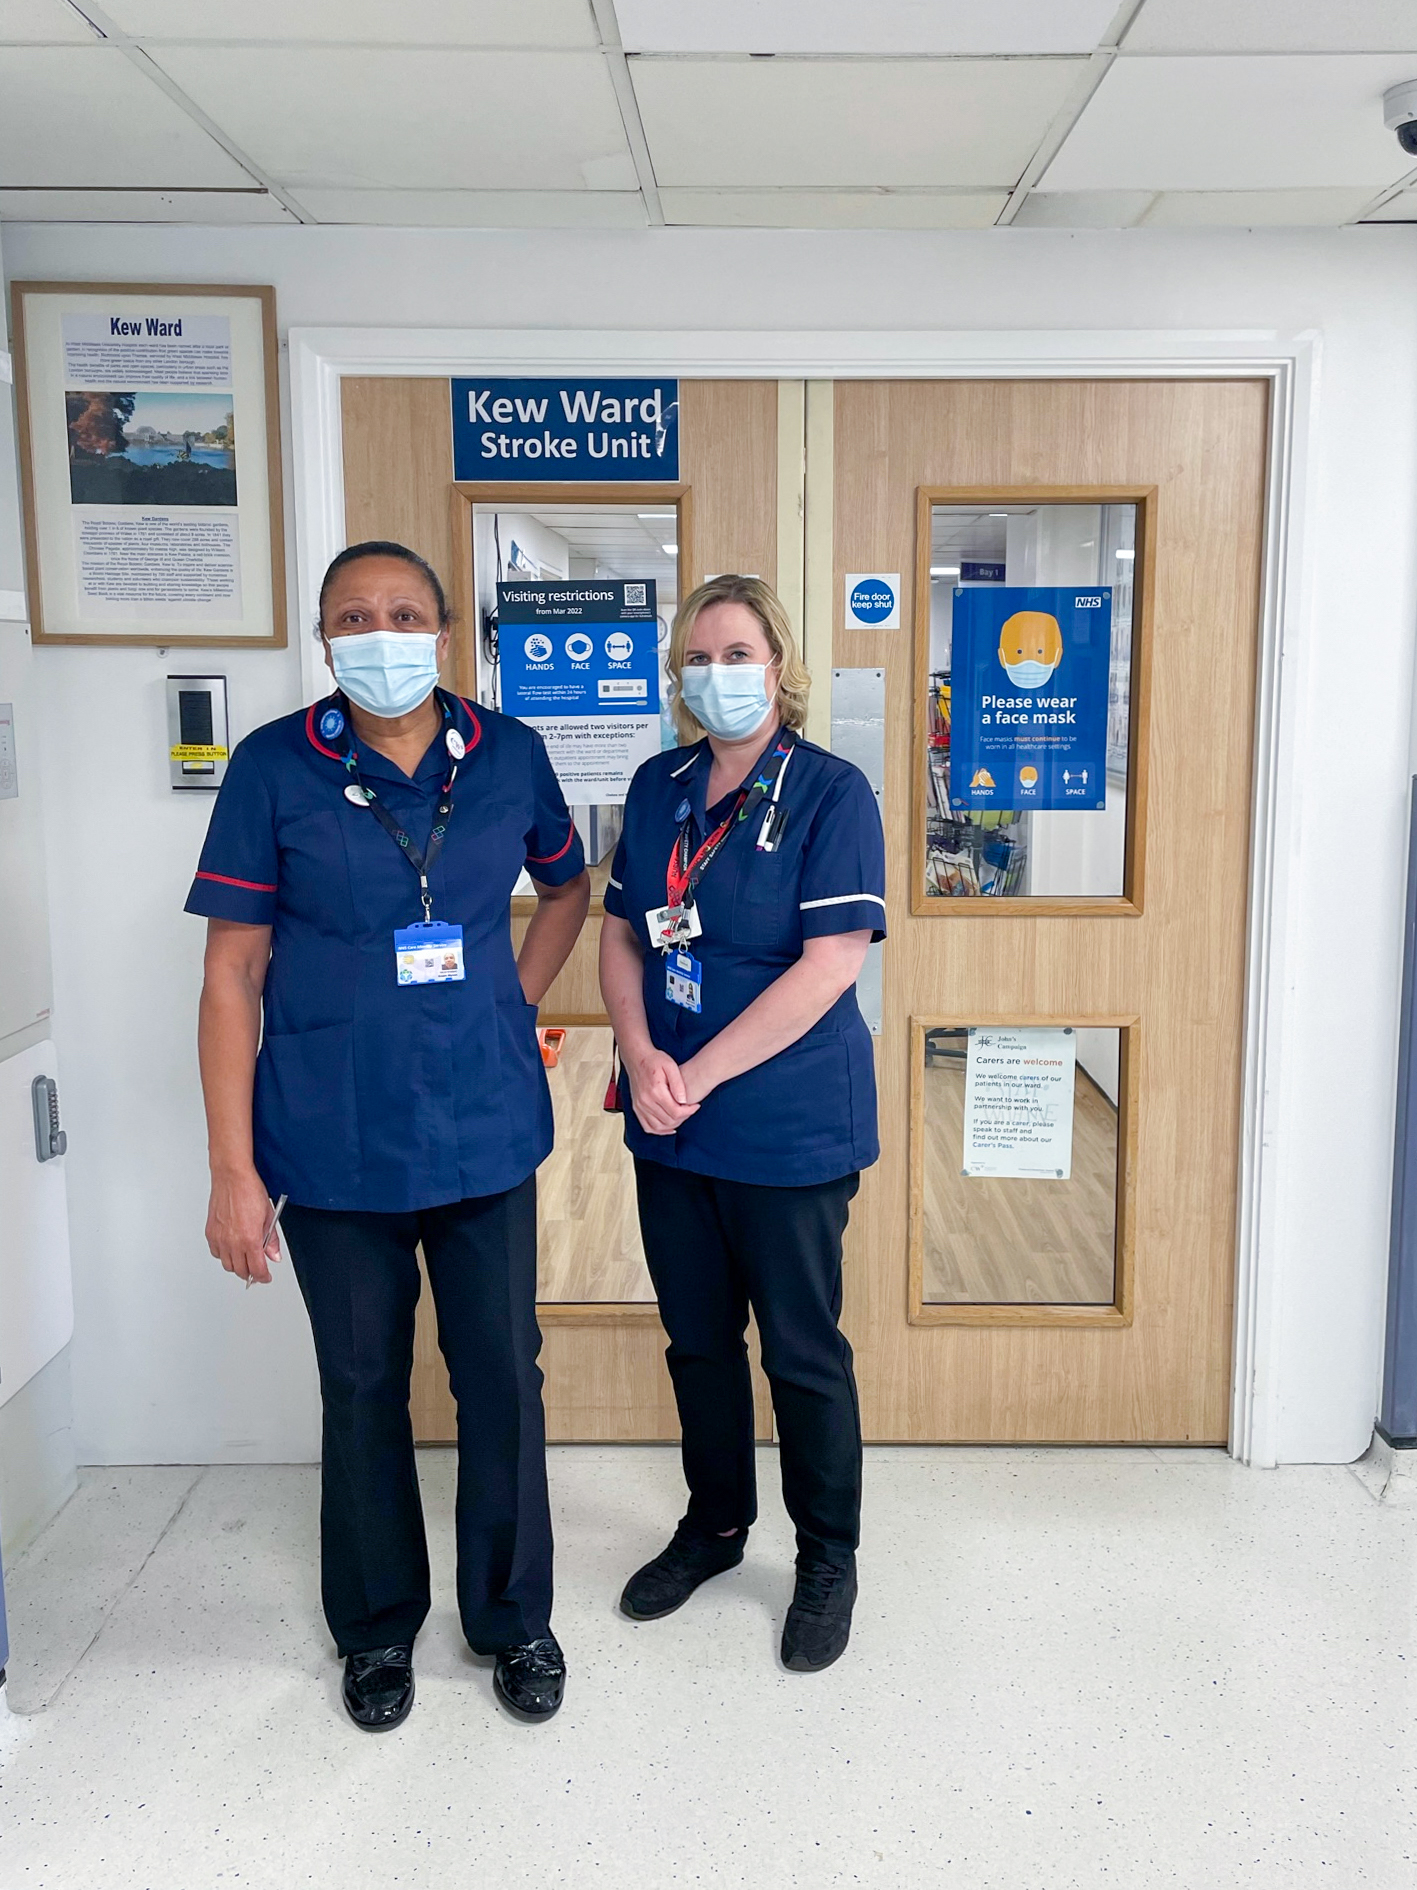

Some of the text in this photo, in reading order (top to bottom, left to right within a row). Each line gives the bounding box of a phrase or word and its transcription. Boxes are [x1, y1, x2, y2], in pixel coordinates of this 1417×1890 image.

[110, 317, 182, 336] Kew Ward
[468, 388, 662, 423] Kew Ward
[480, 431, 651, 459] Stroke Unit
[979, 568, 994, 577] Bay
[502, 589, 614, 604] Visiting restrictions
[854, 592, 891, 600] Fire door
[851, 600, 892, 609] keep shut
[1076, 597, 1100, 607] NHS
[571, 662, 590, 670] FACE
[607, 661, 632, 669] SPACE
[982, 695, 1077, 708] Please wear
[982, 710, 1076, 724] a face mask
[560, 723, 589, 731] allowed
[635, 723, 649, 731] per
[593, 732, 636, 740] exceptions:
[1023, 1058, 1063, 1066] welcome
